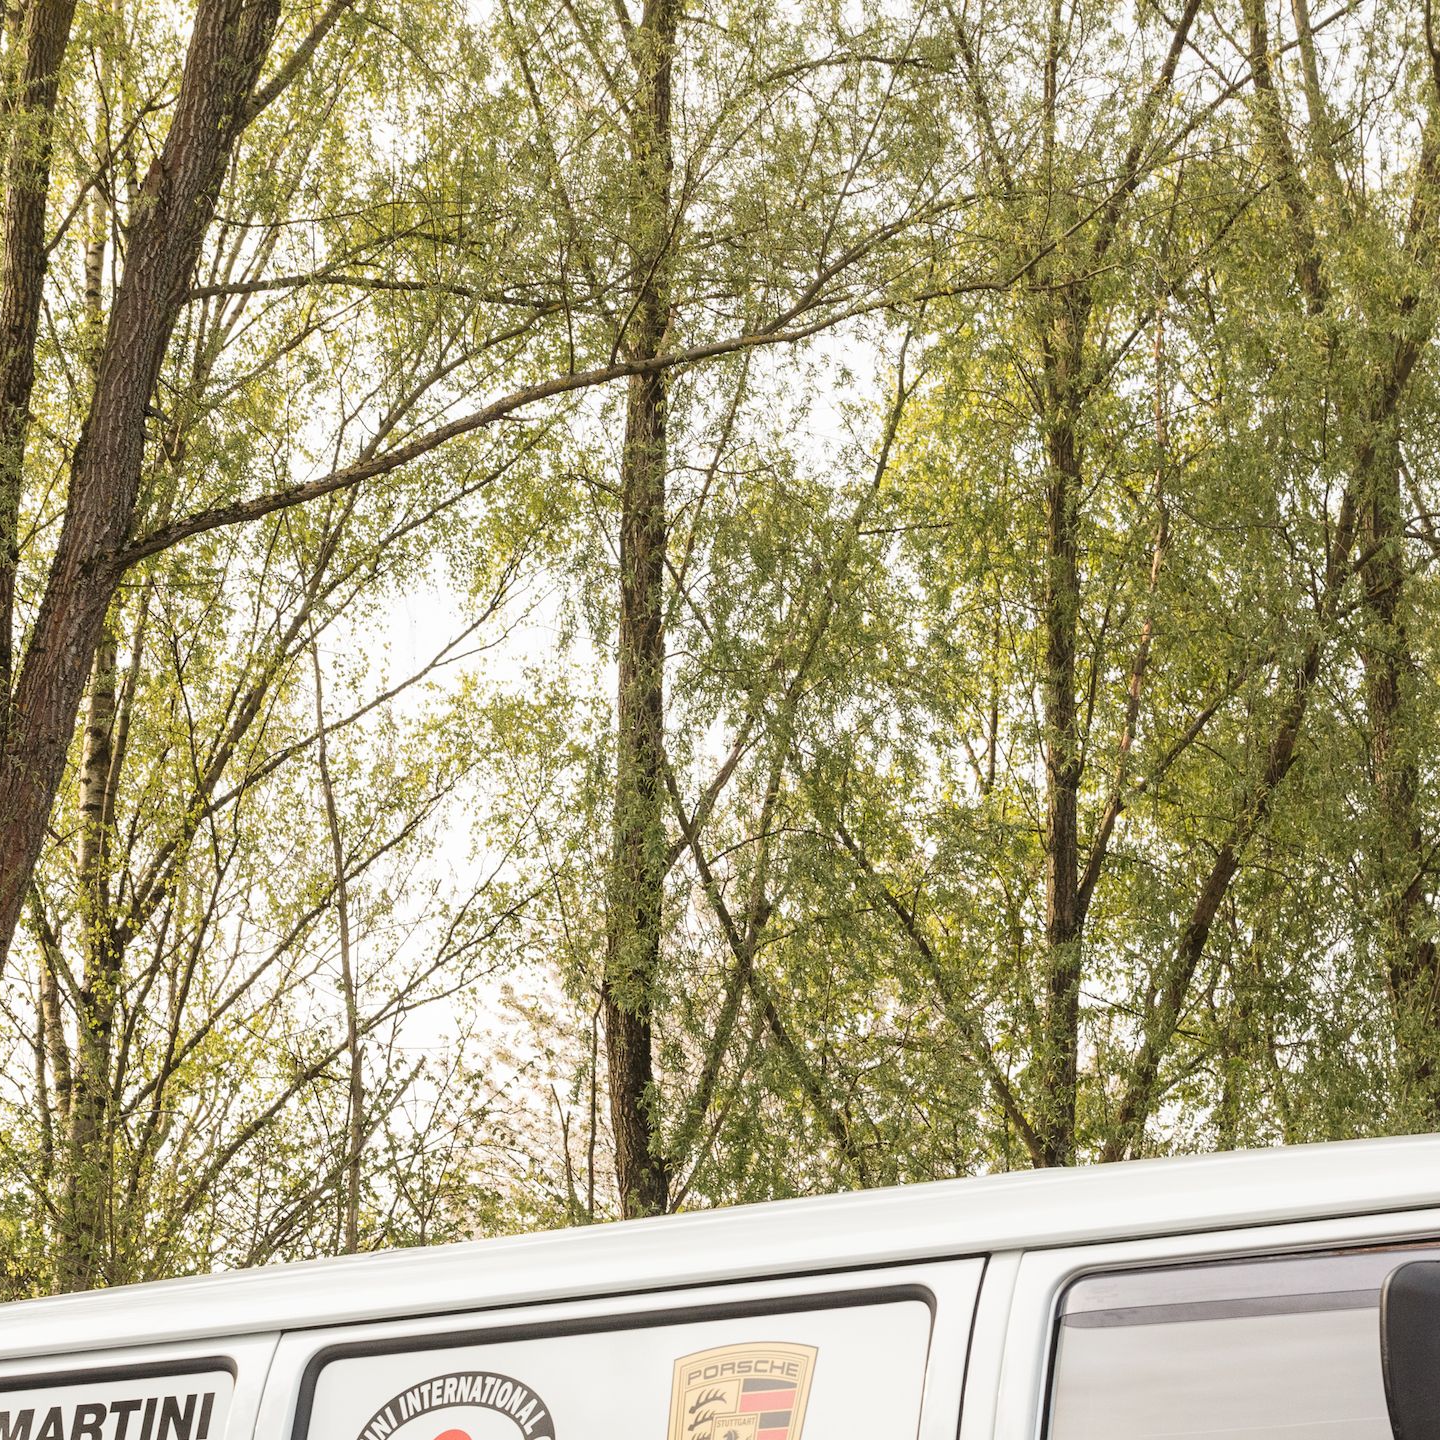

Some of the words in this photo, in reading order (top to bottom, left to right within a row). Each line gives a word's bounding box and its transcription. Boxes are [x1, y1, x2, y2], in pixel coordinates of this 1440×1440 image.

[687, 1359, 800, 1386] PORSCHE
[398, 1375, 546, 1436] INTERNATIONAL
[716, 1416, 756, 1429] STUTTGART
